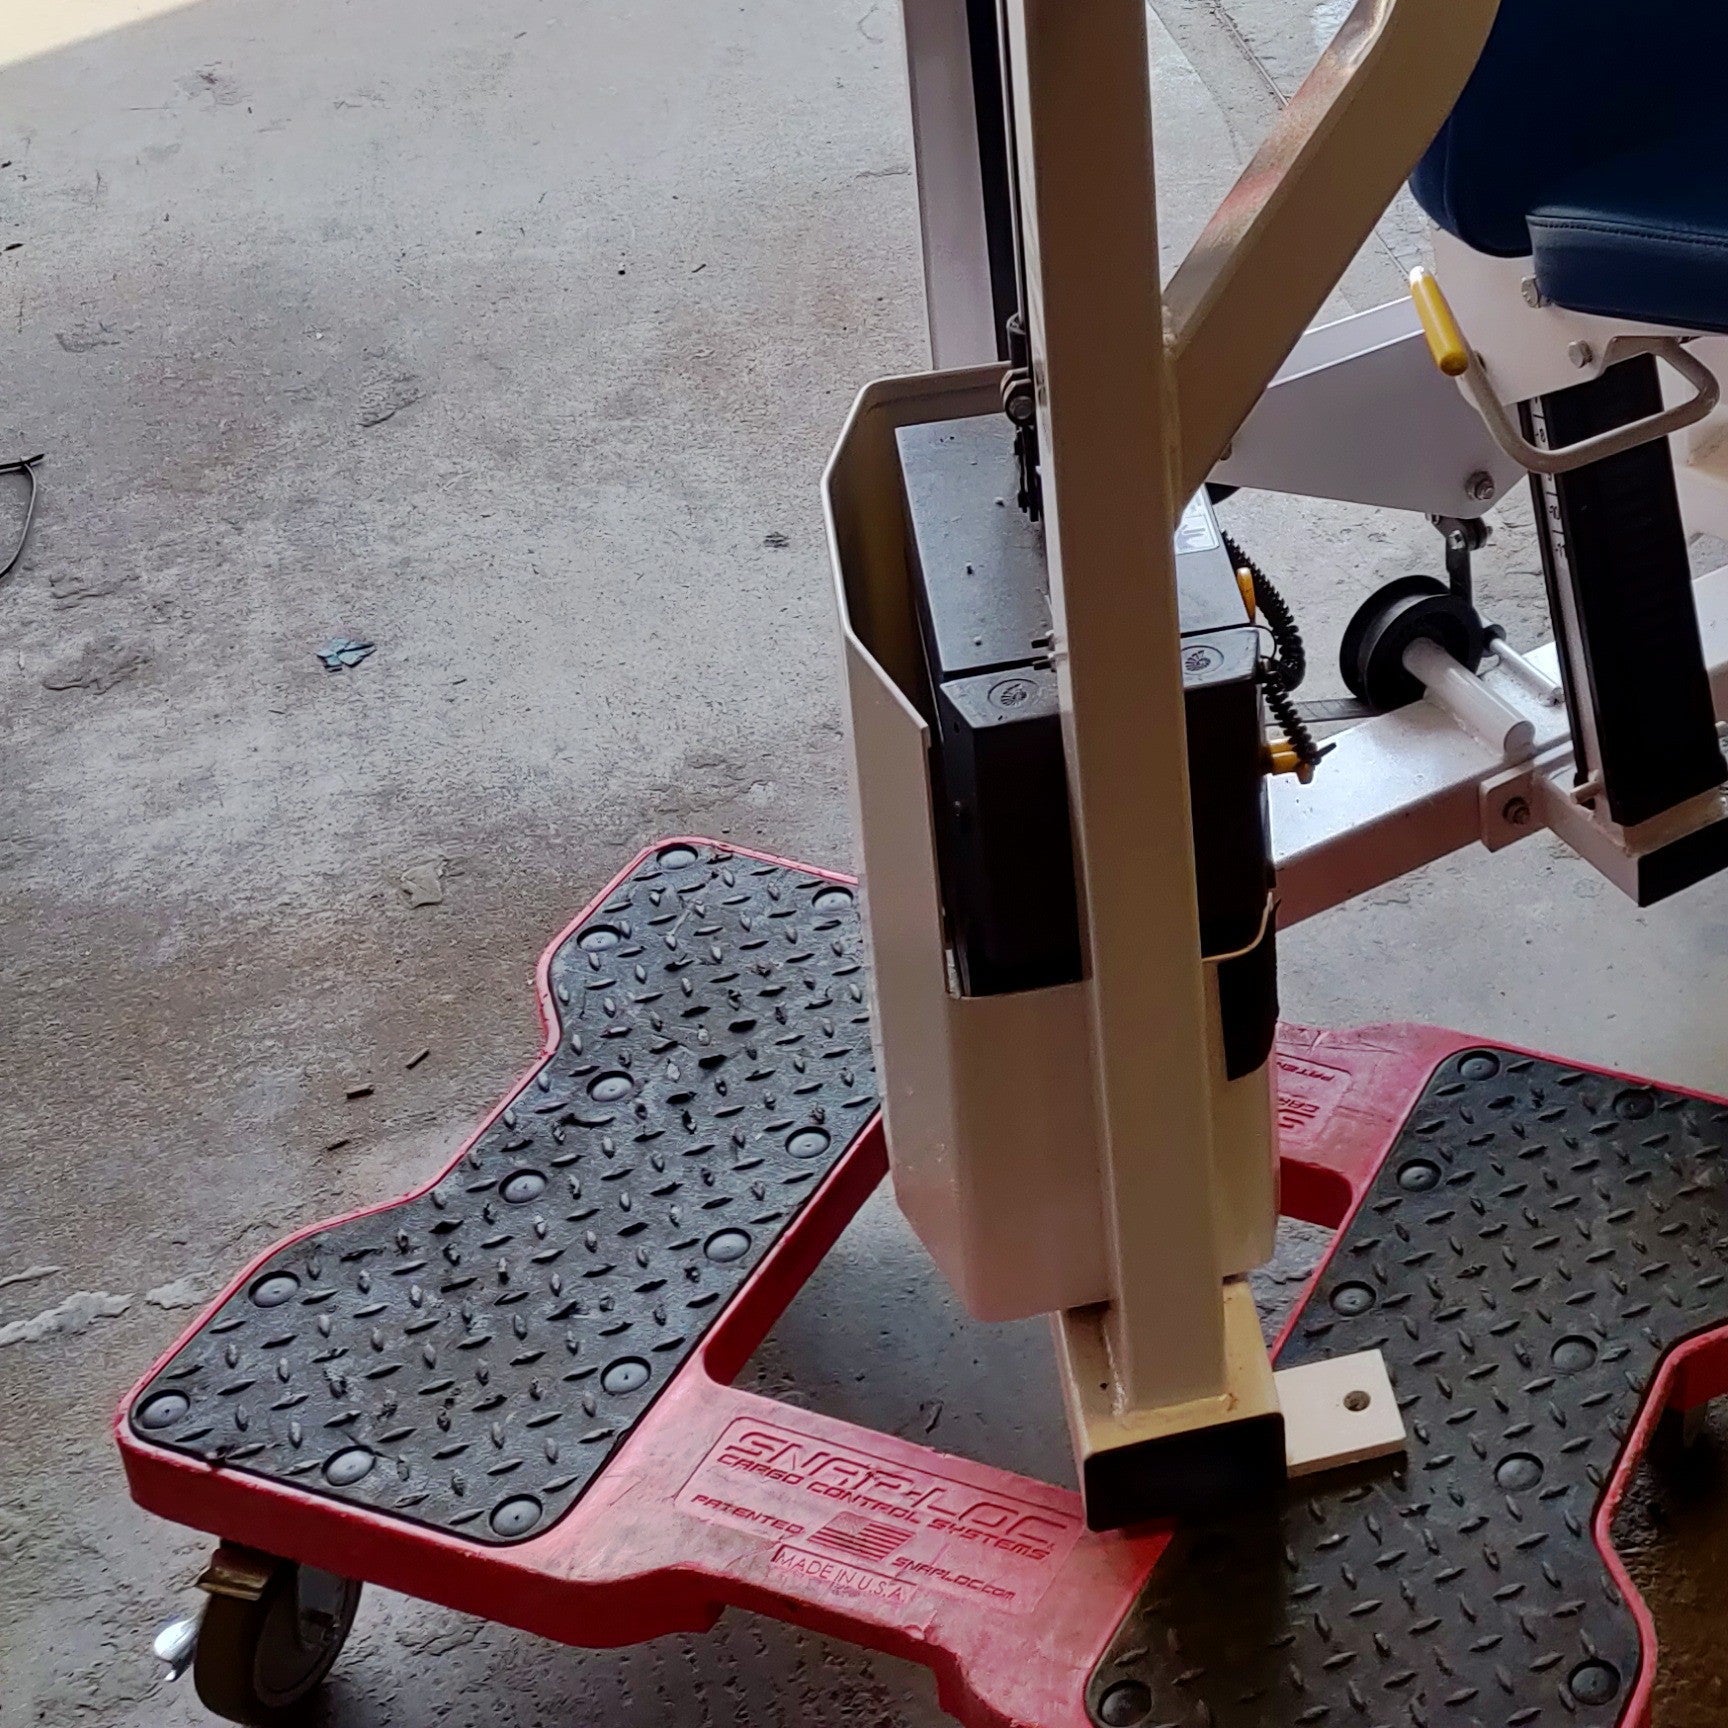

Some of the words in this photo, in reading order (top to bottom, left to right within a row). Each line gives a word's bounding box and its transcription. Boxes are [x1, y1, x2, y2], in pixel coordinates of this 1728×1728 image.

[690, 1494, 805, 1535] PATENTED
[717, 1453, 804, 1486] CARGO
[807, 1481, 921, 1525] CONTROL
[927, 1518, 1050, 1561] SYSTEMS
[776, 1551, 834, 1579] MADE
[834, 1568, 857, 1584] IN
